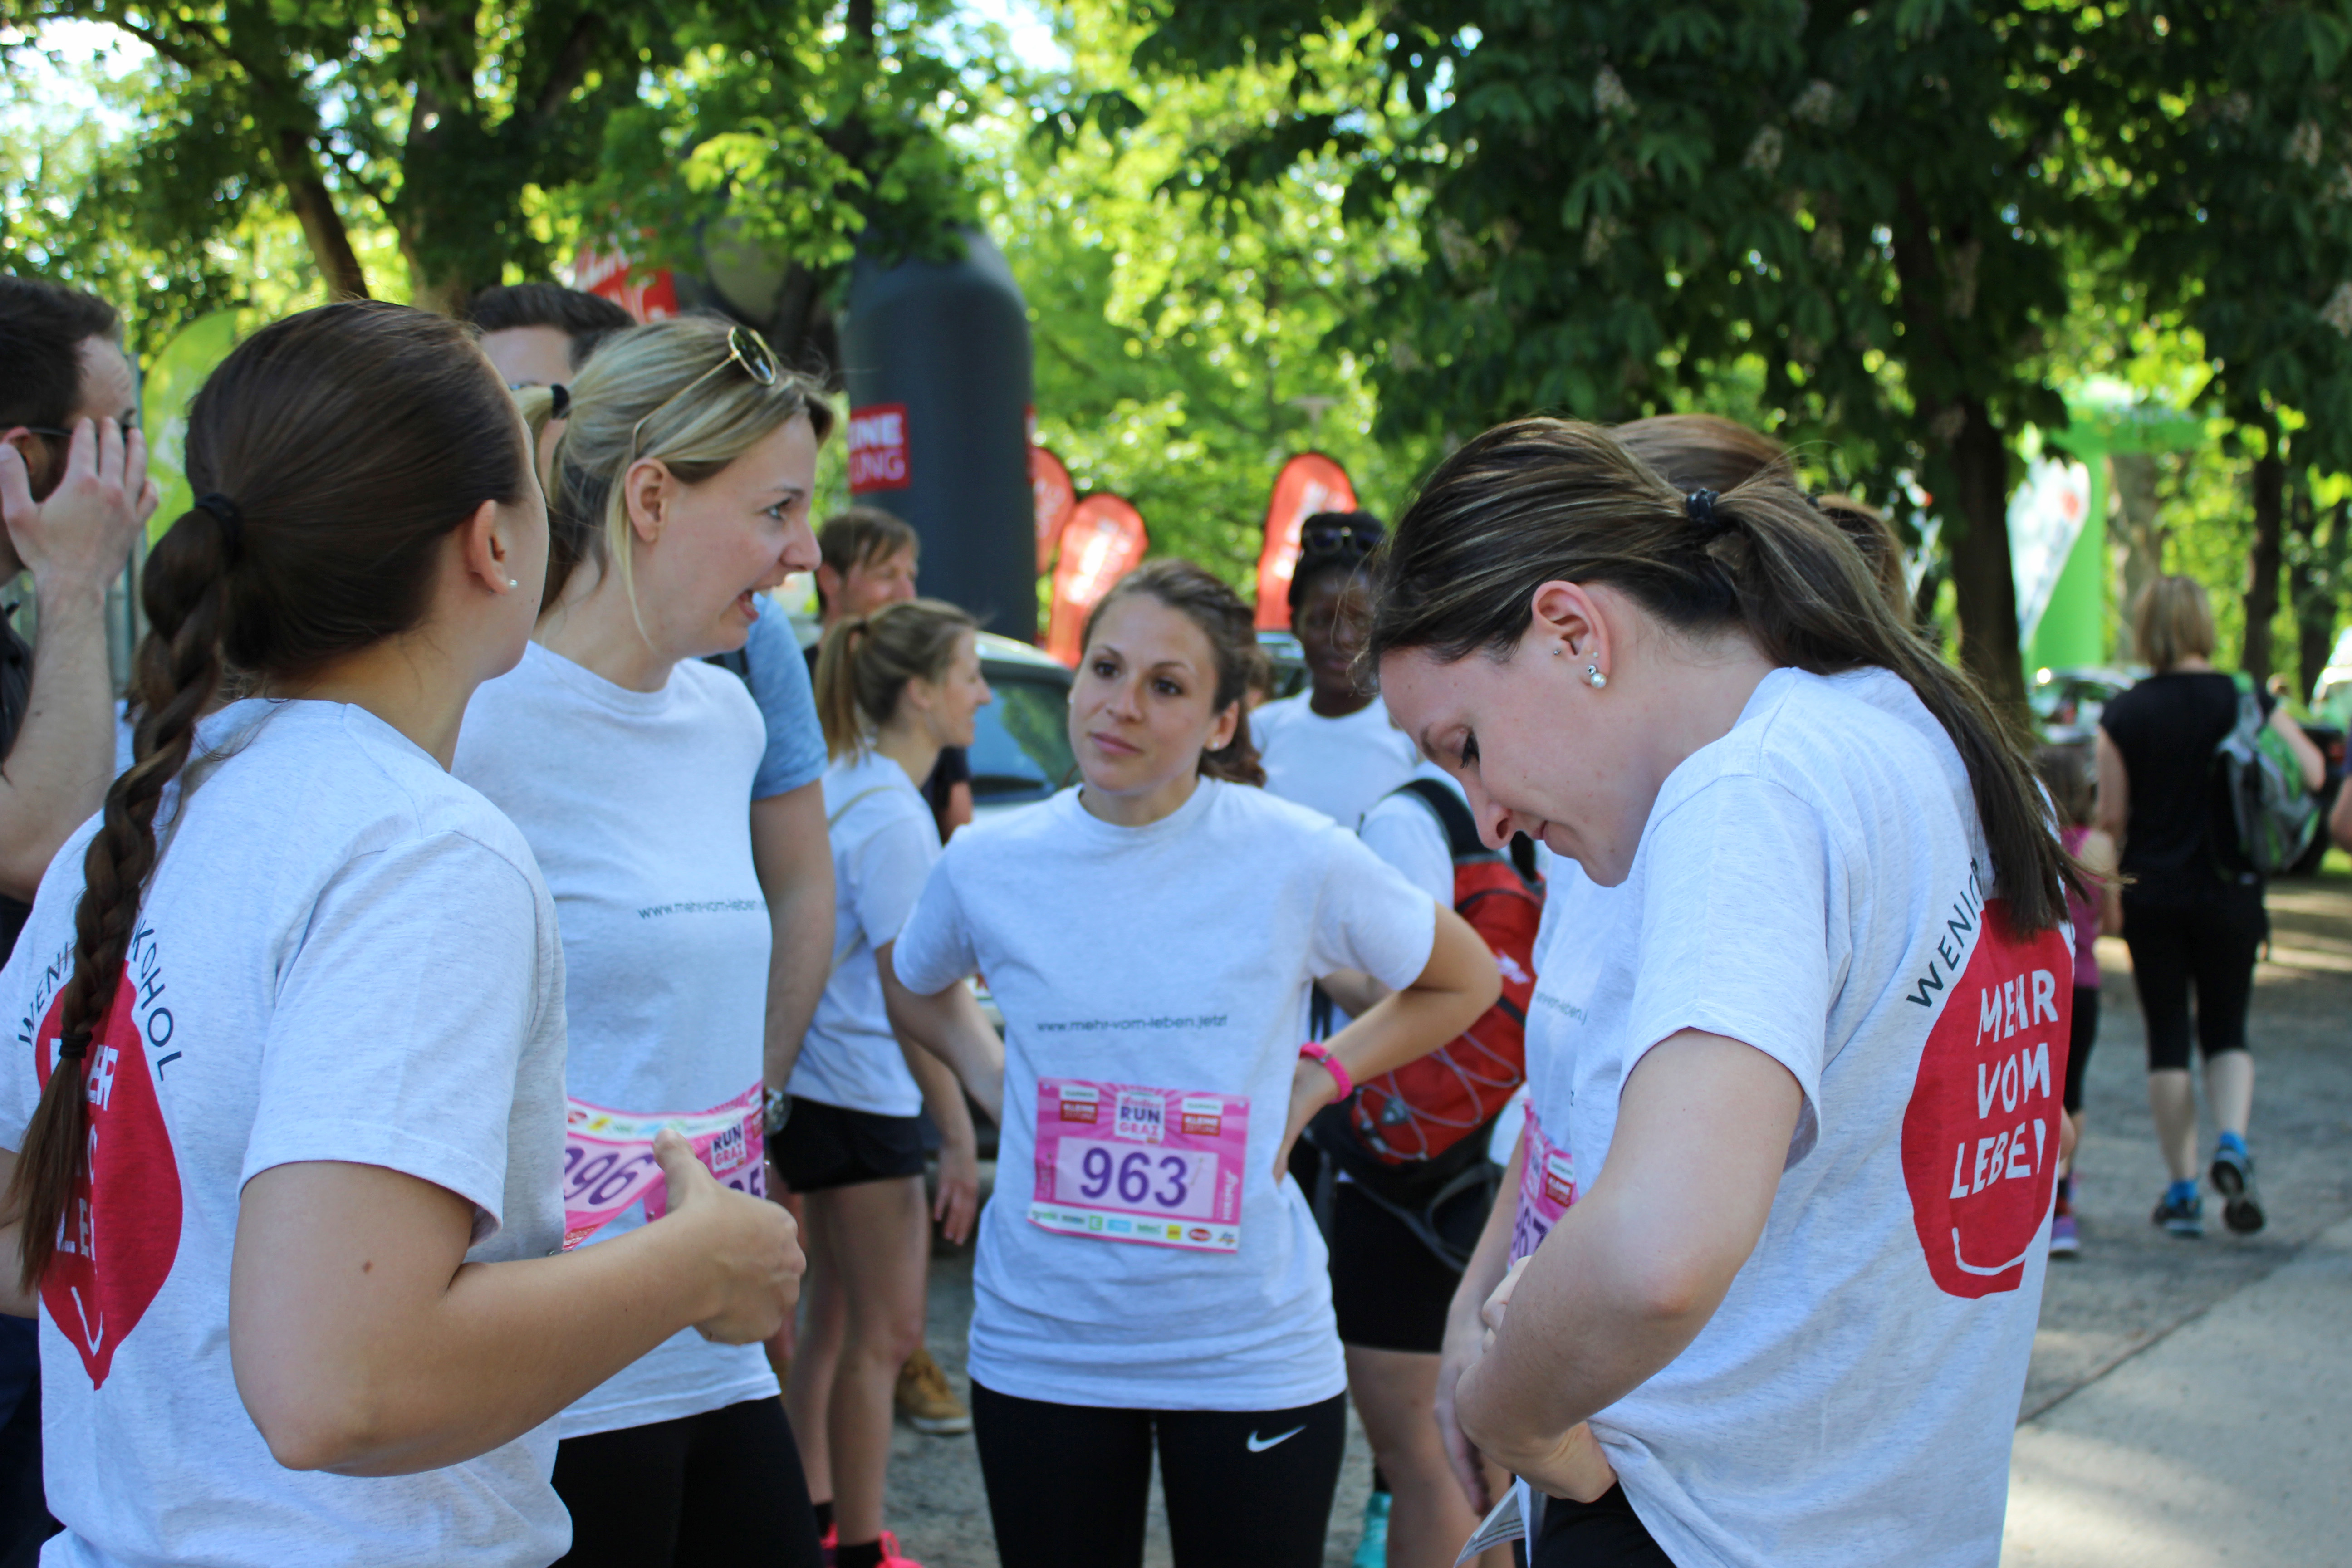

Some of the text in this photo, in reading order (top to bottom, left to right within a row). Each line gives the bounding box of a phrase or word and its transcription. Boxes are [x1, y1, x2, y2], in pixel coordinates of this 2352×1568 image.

[1977, 1042, 2051, 1120] VOM
[1120, 1106, 1160, 1123] RUN
[714, 1124, 741, 1152] RUN
[1119, 1122, 1159, 1136] GRAZ
[1080, 1147, 1187, 1208] 963
